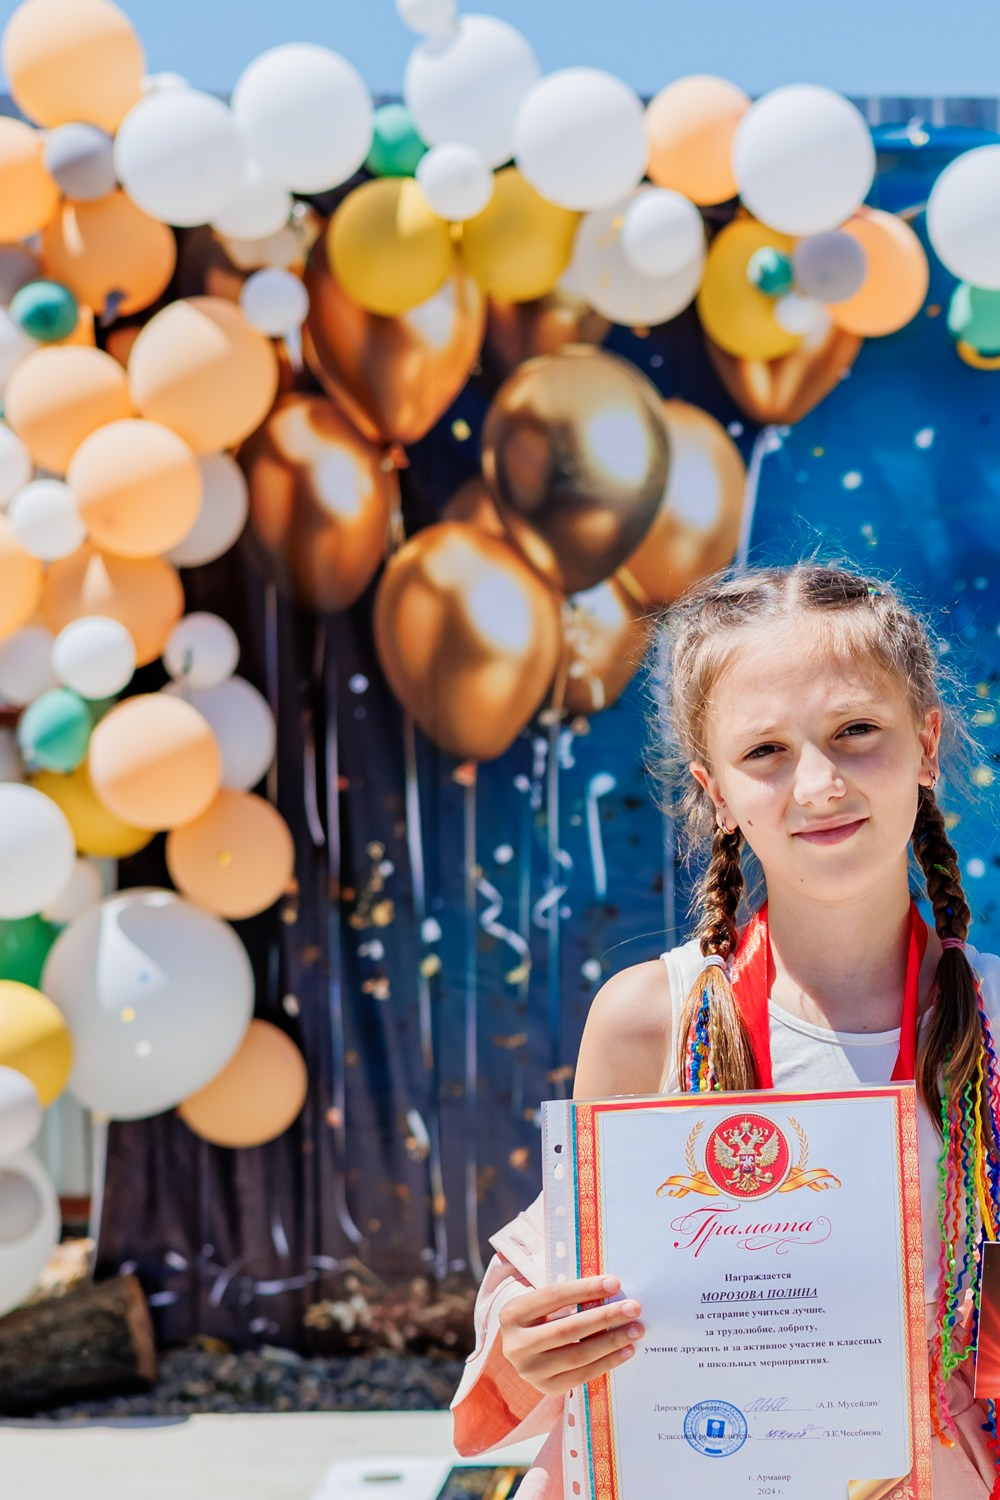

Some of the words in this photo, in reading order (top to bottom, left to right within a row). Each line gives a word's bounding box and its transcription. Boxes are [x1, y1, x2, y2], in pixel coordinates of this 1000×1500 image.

[670, 1202, 832, 1257] Грамота
[724, 1272, 792, 1284] Награждается
[700, 1289, 764, 1302] МОРОЗОВА
[767, 1287, 818, 1299] ПОЛИНА
[695, 1312, 705, 1320] за
[707, 1310, 750, 1321] старание
[752, 1308, 790, 1319] учиться
[792, 1306, 826, 1317] лучше,
[705, 1329, 714, 1337] за
[717, 1325, 776, 1338] трудолюбие,
[778, 1323, 818, 1334] доброту,
[645, 1346, 678, 1355] умение
[680, 1345, 721, 1355] дружить
[732, 1344, 741, 1352] за
[743, 1342, 787, 1351] активное
[789, 1340, 826, 1351] участие
[828, 1340, 835, 1348] в
[837, 1338, 882, 1347] классных
[707, 1360, 757, 1369] школьных
[760, 1357, 830, 1368] мероприятиях.
[653, 1404, 691, 1412] Директор
[756, 1474, 792, 1482] Армавир
